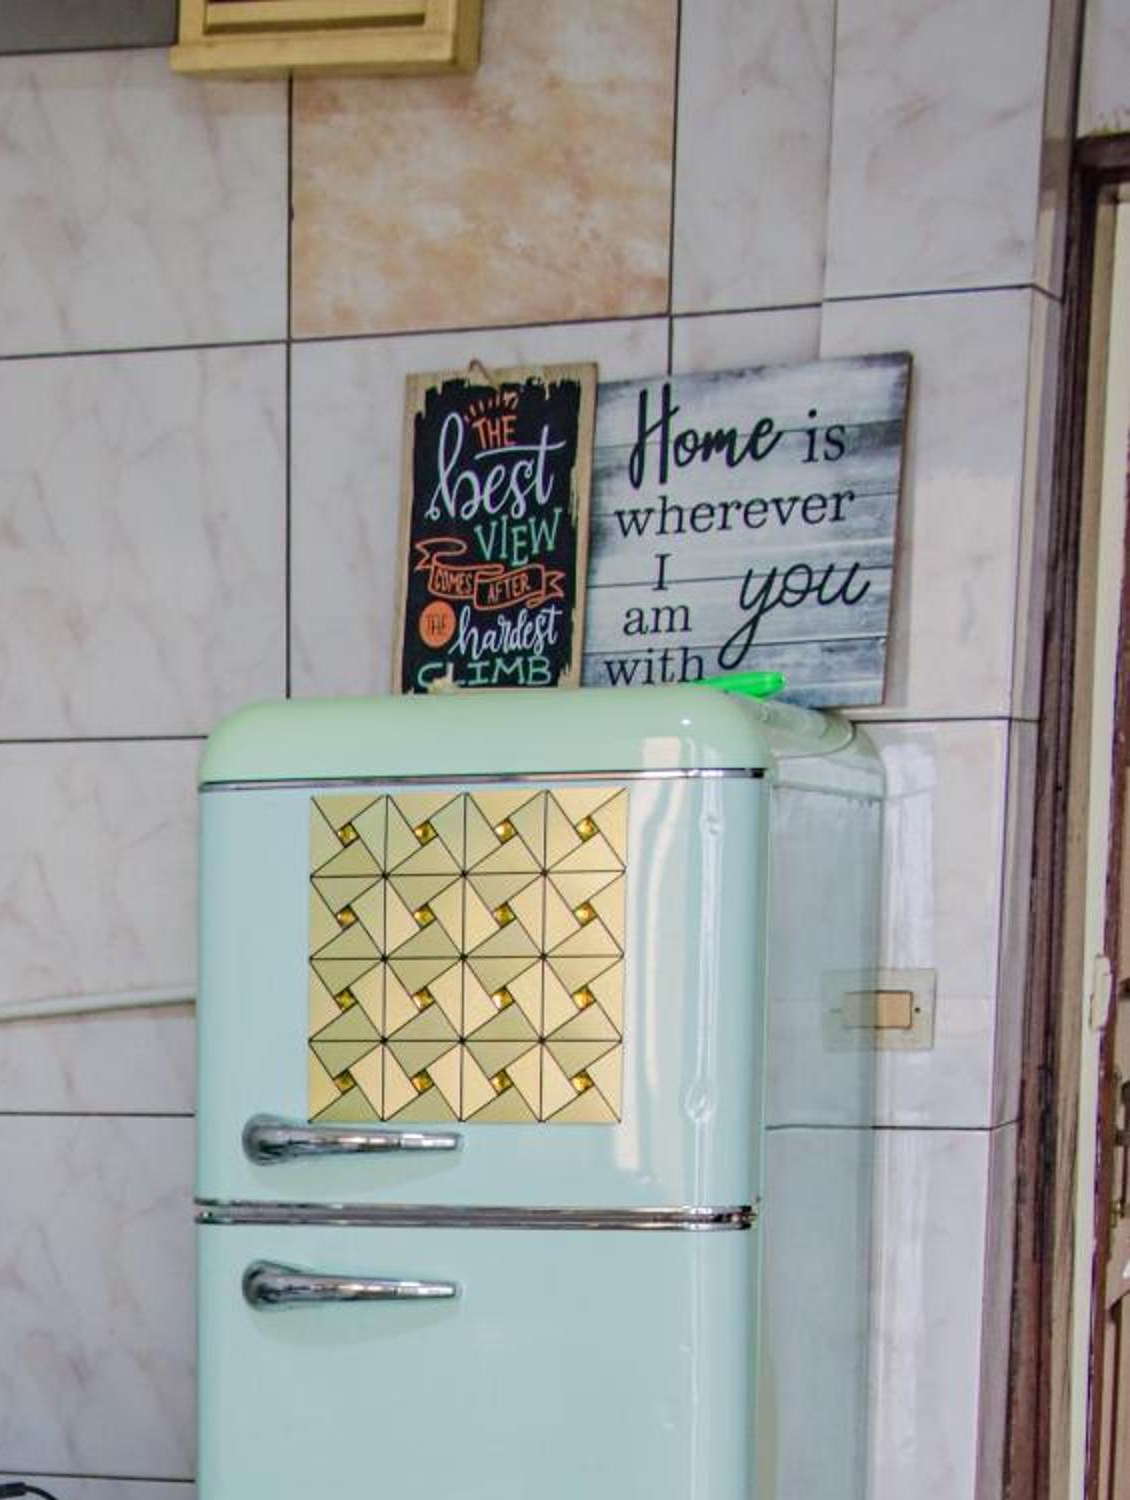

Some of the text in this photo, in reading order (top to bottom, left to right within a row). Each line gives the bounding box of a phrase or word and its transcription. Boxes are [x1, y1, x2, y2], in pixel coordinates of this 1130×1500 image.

[472, 415, 518, 449] THE
[629, 383, 847, 489] Home is
[424, 412, 566, 520] best
[614, 488, 855, 538] wherever
[473, 507, 563, 566] VIEW
[435, 568, 531, 602] COMES AFTER
[652, 553, 672, 592] I
[448, 604, 562, 660] hardest
[623, 604, 692, 636] am
[718, 561, 870, 671] you
[418, 656, 552, 689] CLIMB
[604, 646, 705, 686] with
